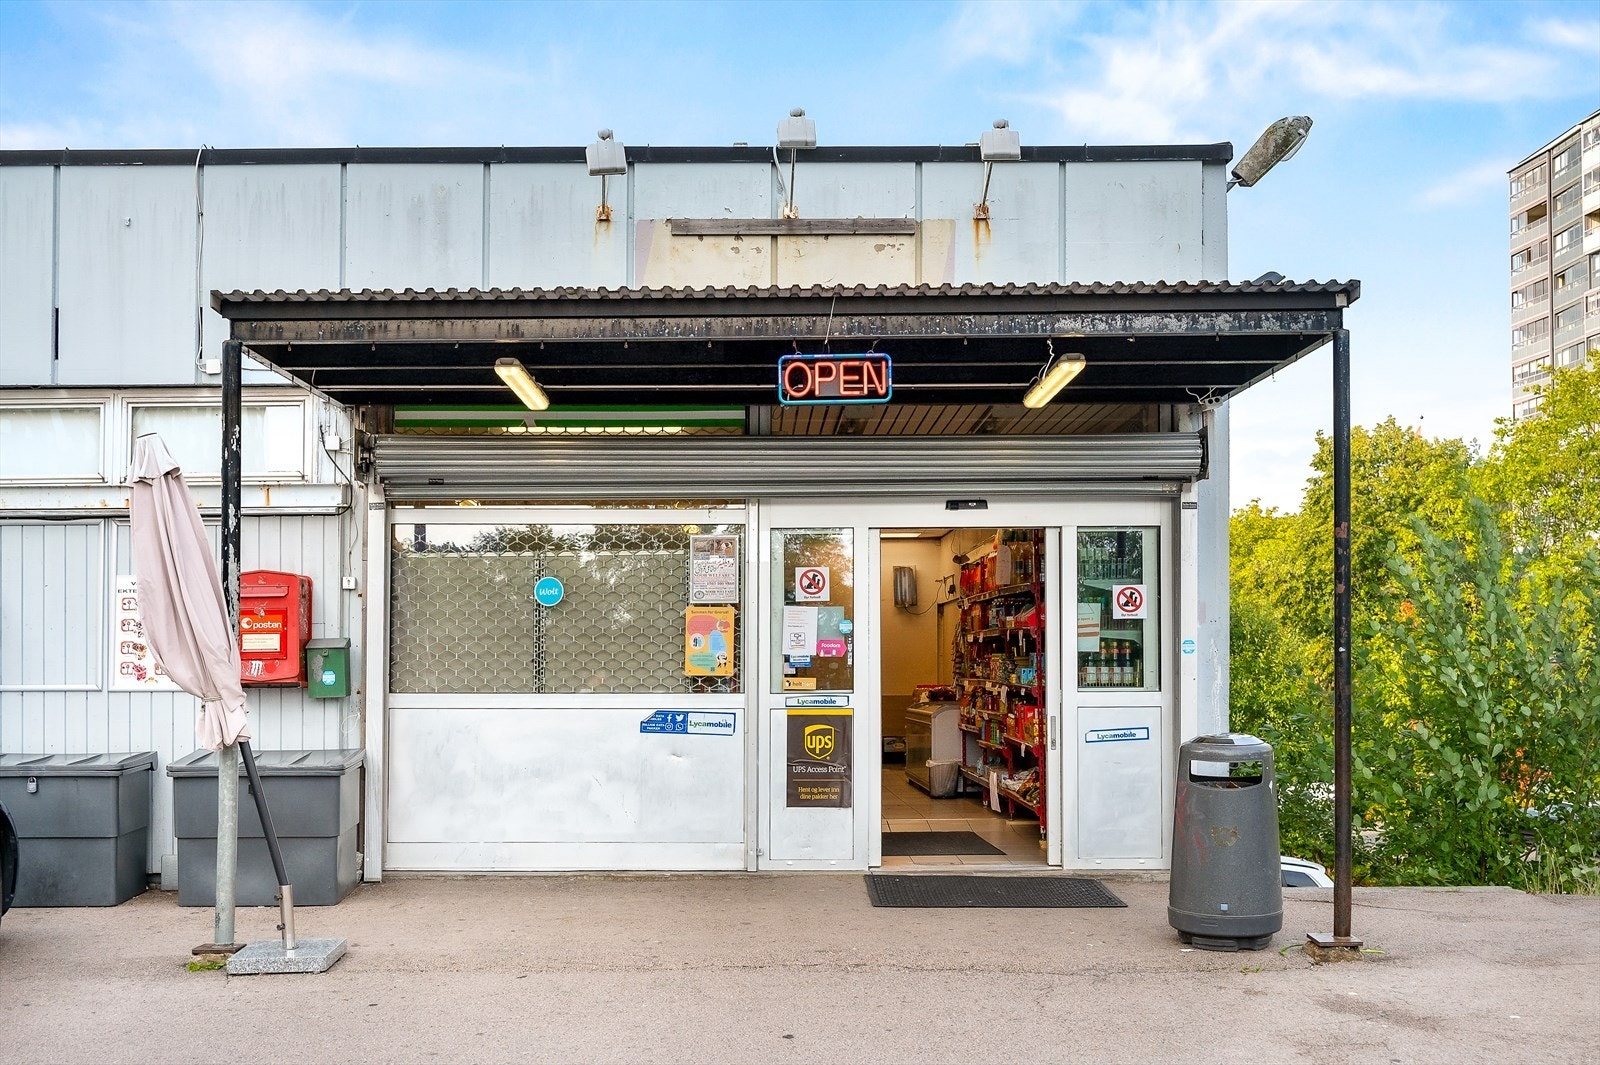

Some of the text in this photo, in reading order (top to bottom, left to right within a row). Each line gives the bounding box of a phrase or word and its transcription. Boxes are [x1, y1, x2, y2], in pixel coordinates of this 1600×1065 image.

[784, 361, 886, 398] OPEN
[253, 622, 282, 630] posten
[689, 720, 732, 728] Lycamobile
[1097, 731, 1136, 740] Lycamobile
[807, 736, 832, 754] ups
